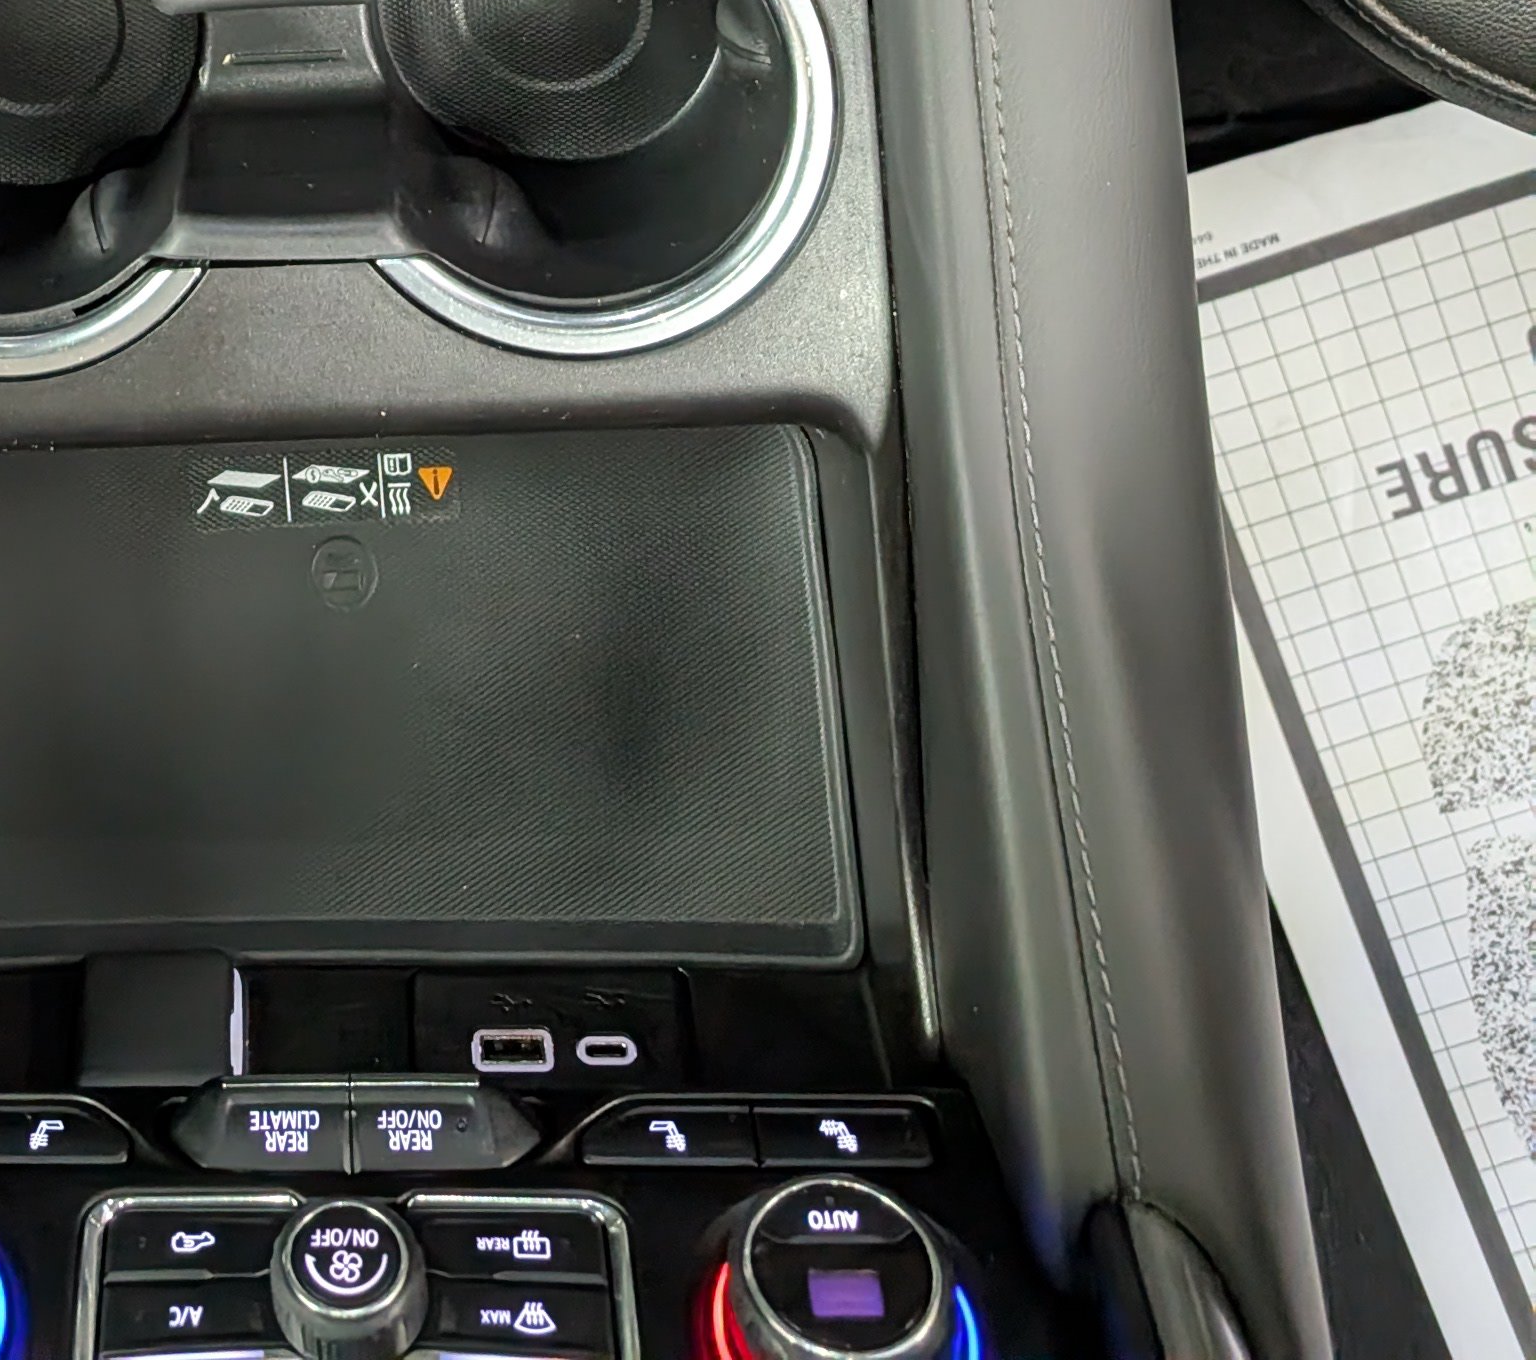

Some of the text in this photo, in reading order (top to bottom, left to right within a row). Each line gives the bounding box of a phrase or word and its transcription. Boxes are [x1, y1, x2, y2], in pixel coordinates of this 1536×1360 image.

[1223, 247, 1237, 260] IN
[1240, 233, 1280, 254] MADE
[249, 1110, 320, 1130] CLIMATE
[377, 1110, 442, 1130] ON/OFF
[265, 1130, 308, 1152] REAR
[388, 1130, 432, 1151] REAR
[808, 1210, 858, 1231] AUTO
[310, 1228, 379, 1247] ON/OFF
[476, 1236, 510, 1251] REAR
[169, 1306, 203, 1328] A/C
[480, 1309, 511, 1326] MAX
